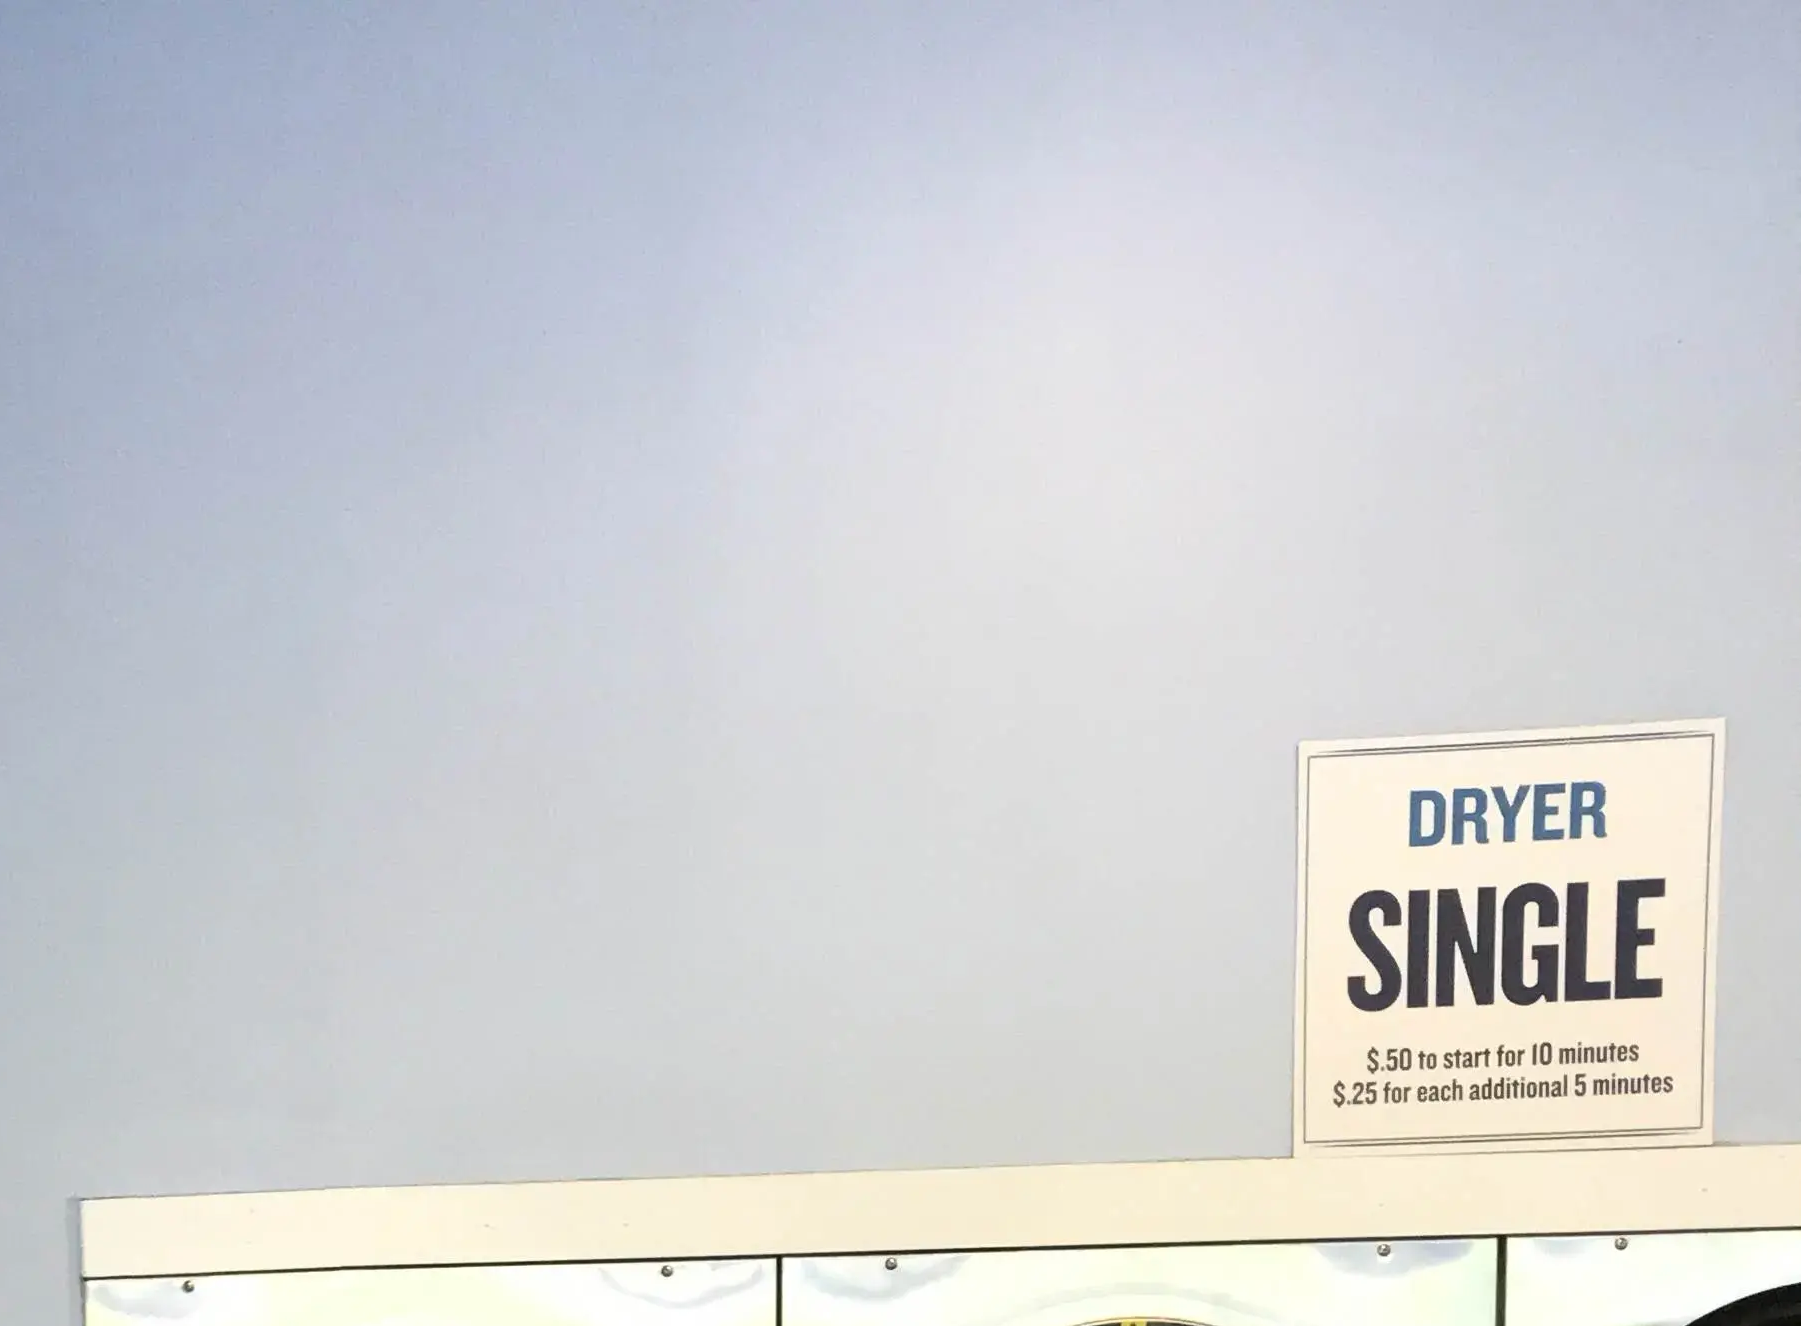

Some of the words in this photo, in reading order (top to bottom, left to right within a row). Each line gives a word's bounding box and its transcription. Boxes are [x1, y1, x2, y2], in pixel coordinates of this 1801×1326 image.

[1408, 781, 1608, 847] DRYER
[1346, 877, 1667, 1013] SINGLE
[1366, 1046, 1412, 1075] $.50
[1418, 1051, 1437, 1070] to
[1443, 1048, 1491, 1070] start
[1497, 1044, 1525, 1068] for
[1531, 1042, 1553, 1066] 10
[1558, 1041, 1640, 1065] minutes
[1333, 1080, 1378, 1108] $.25
[1383, 1081, 1412, 1104] for
[1417, 1078, 1463, 1103] each
[1469, 1073, 1568, 1101] additional
[1574, 1073, 1587, 1097] 5
[1593, 1073, 1674, 1096] minutes
